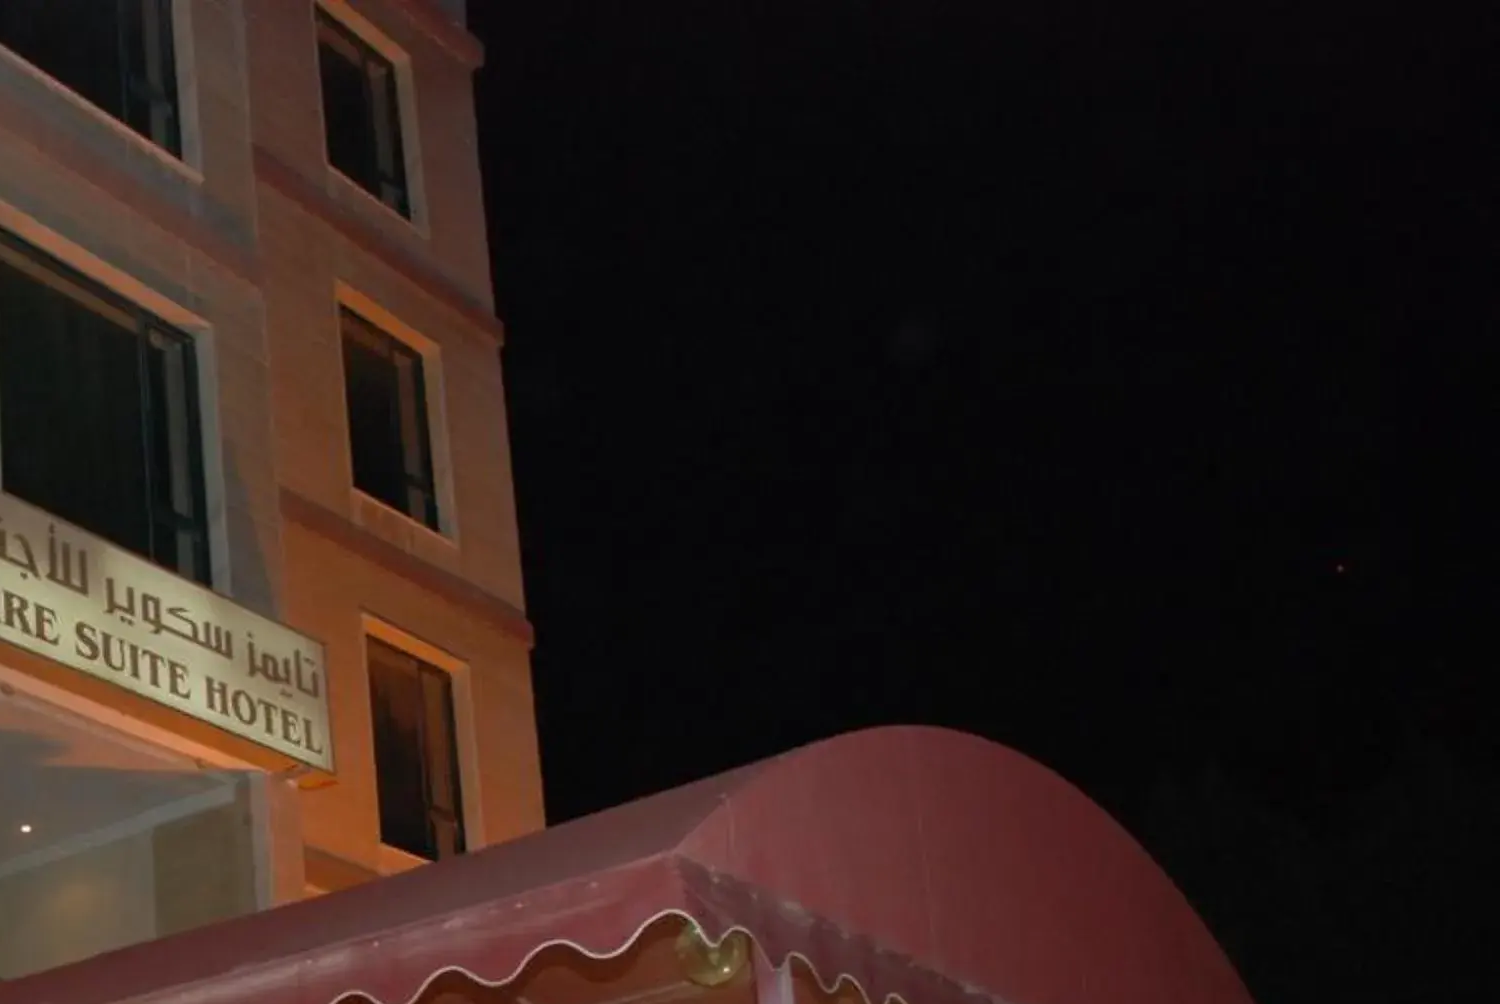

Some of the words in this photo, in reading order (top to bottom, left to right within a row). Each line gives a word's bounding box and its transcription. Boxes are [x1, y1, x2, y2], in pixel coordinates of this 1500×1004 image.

[103, 576, 232, 659] سكوير
[75, 621, 191, 700] SUITE
[205, 676, 322, 756] HOTEL
[247, 631, 320, 699] تايمز
